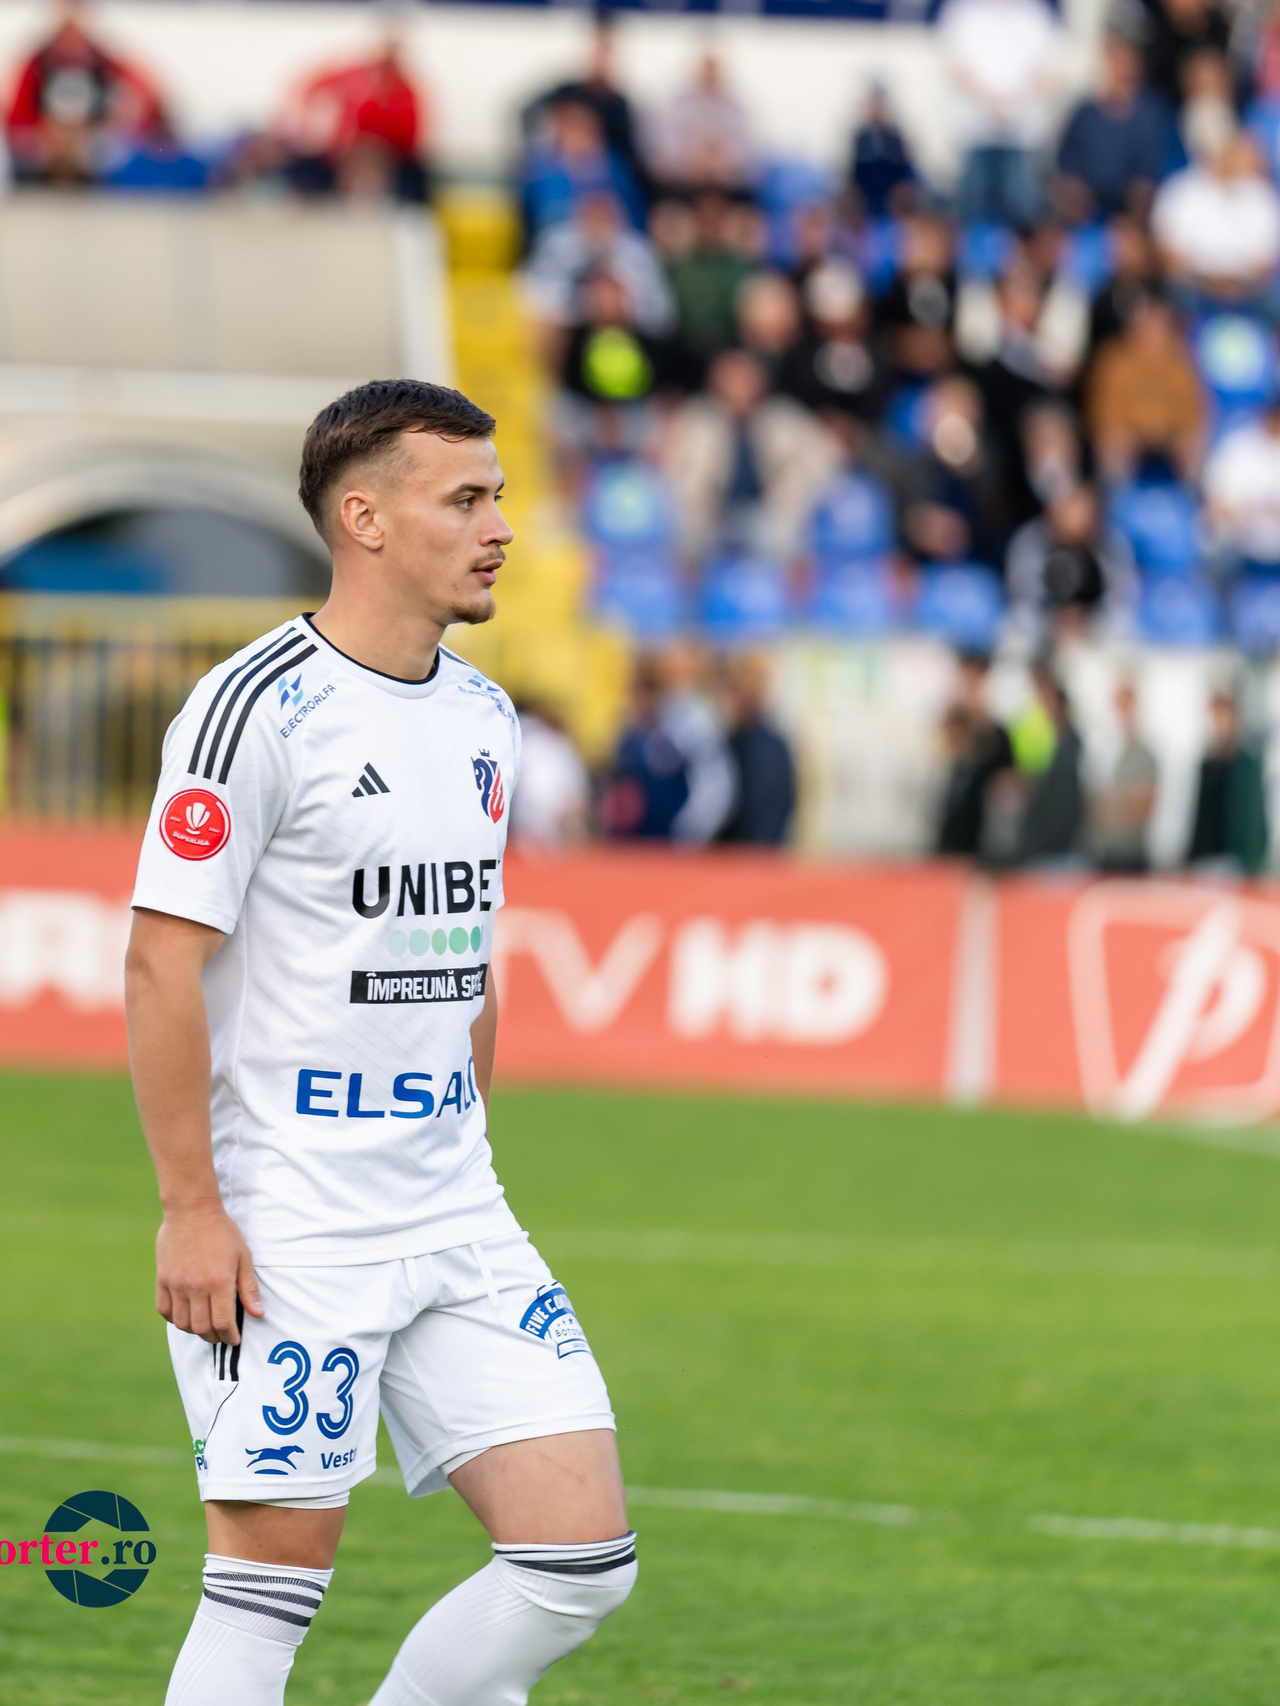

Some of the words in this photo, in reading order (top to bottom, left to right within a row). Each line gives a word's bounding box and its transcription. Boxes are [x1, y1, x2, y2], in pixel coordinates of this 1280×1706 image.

[280, 684, 336, 739] ELECTROALFA
[352, 859, 501, 919] UNIBE
[366, 969, 458, 1001] ÎMPREUNĂ
[668, 915, 890, 1043] HD
[525, 1306, 550, 1335] FIVE
[262, 1340, 360, 1440] 33
